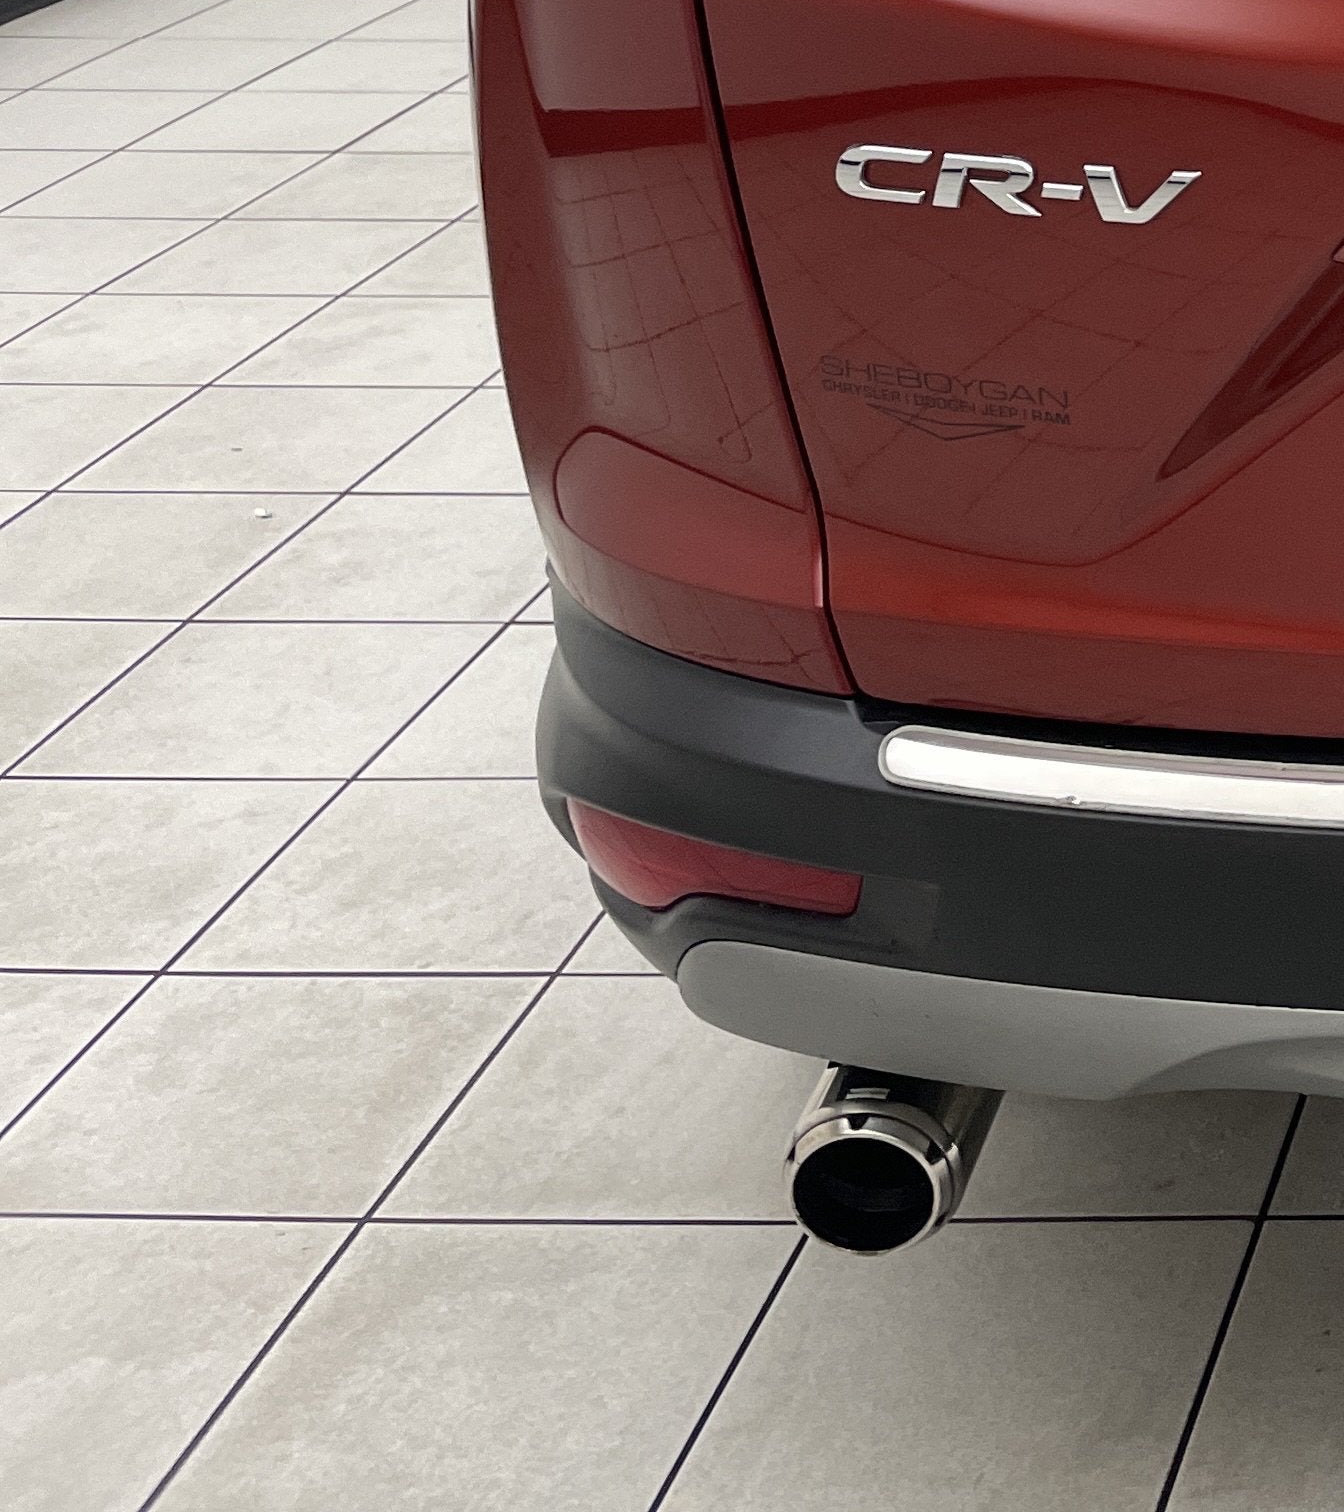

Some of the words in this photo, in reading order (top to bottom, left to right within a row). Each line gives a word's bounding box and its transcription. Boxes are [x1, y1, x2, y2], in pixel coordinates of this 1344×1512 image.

[835, 143, 1203, 224] CR-V
[820, 354, 1071, 409] SHEBOYGAN
[1031, 409, 1072, 426] RAM
